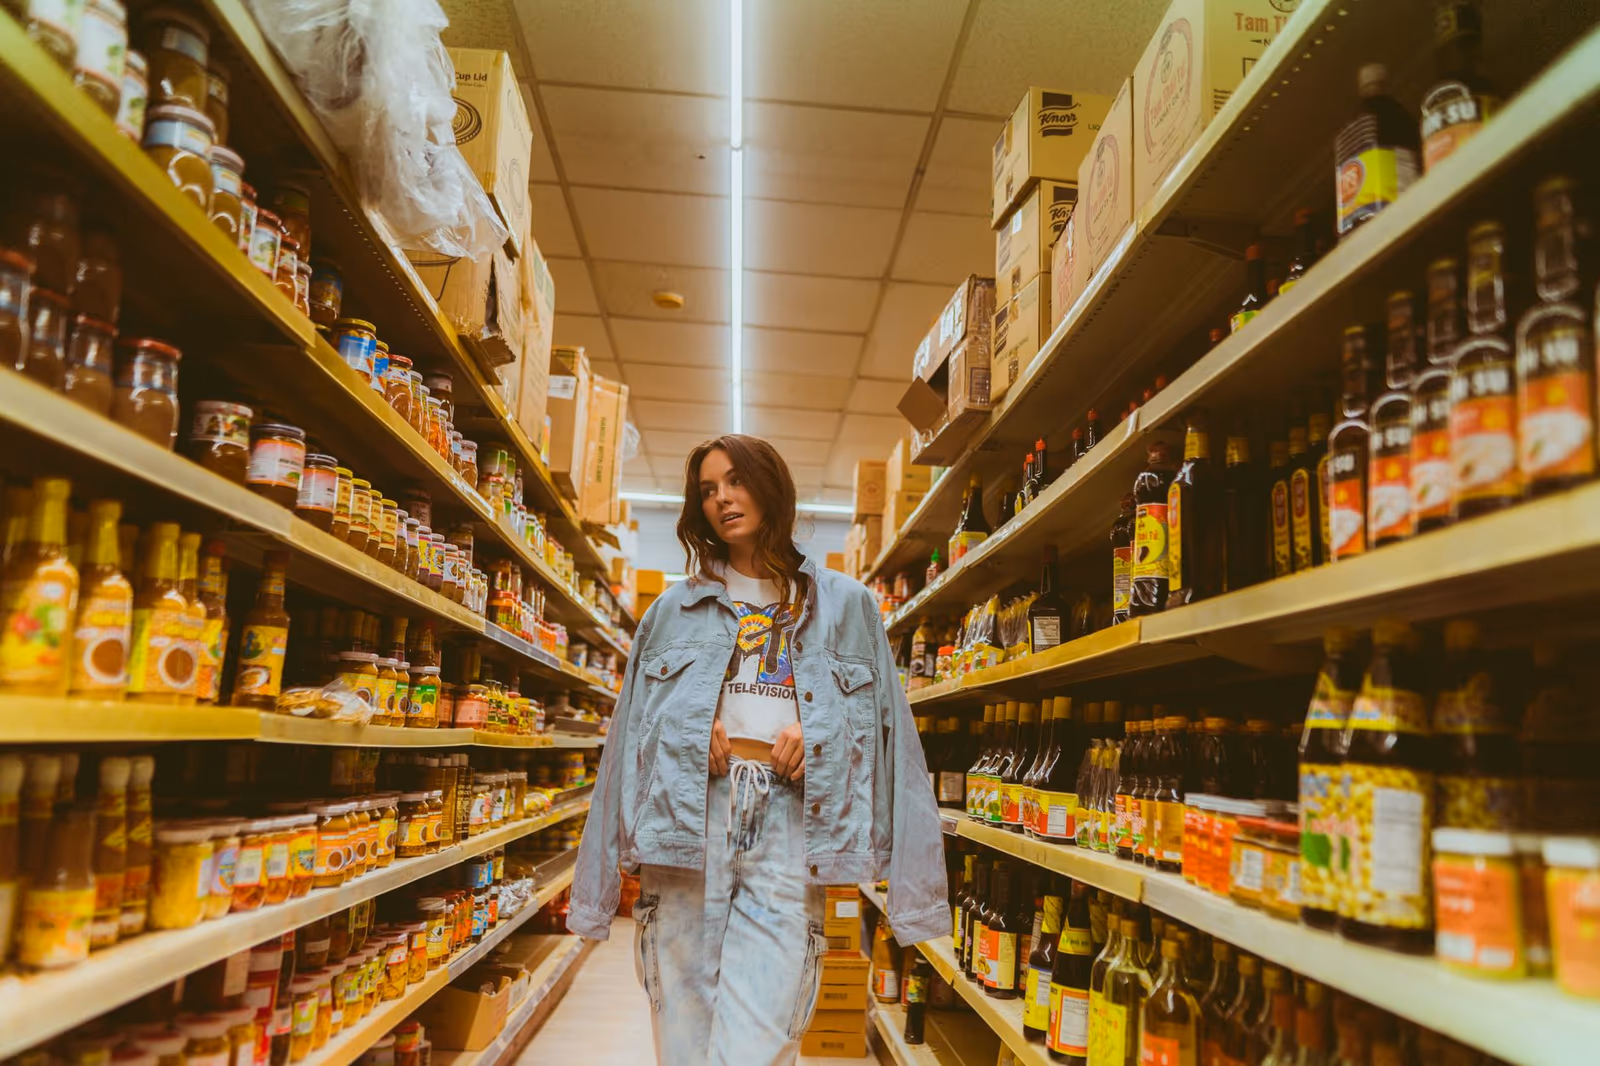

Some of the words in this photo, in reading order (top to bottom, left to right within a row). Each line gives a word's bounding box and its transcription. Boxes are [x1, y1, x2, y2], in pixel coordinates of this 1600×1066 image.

[1233, 12, 1268, 33] Tam
[1274, 15, 1288, 33] T
[454, 71, 471, 81] Cup
[473, 73, 487, 81] Lid
[1038, 110, 1078, 126] Knorr
[728, 683, 796, 699] TELEVISION
